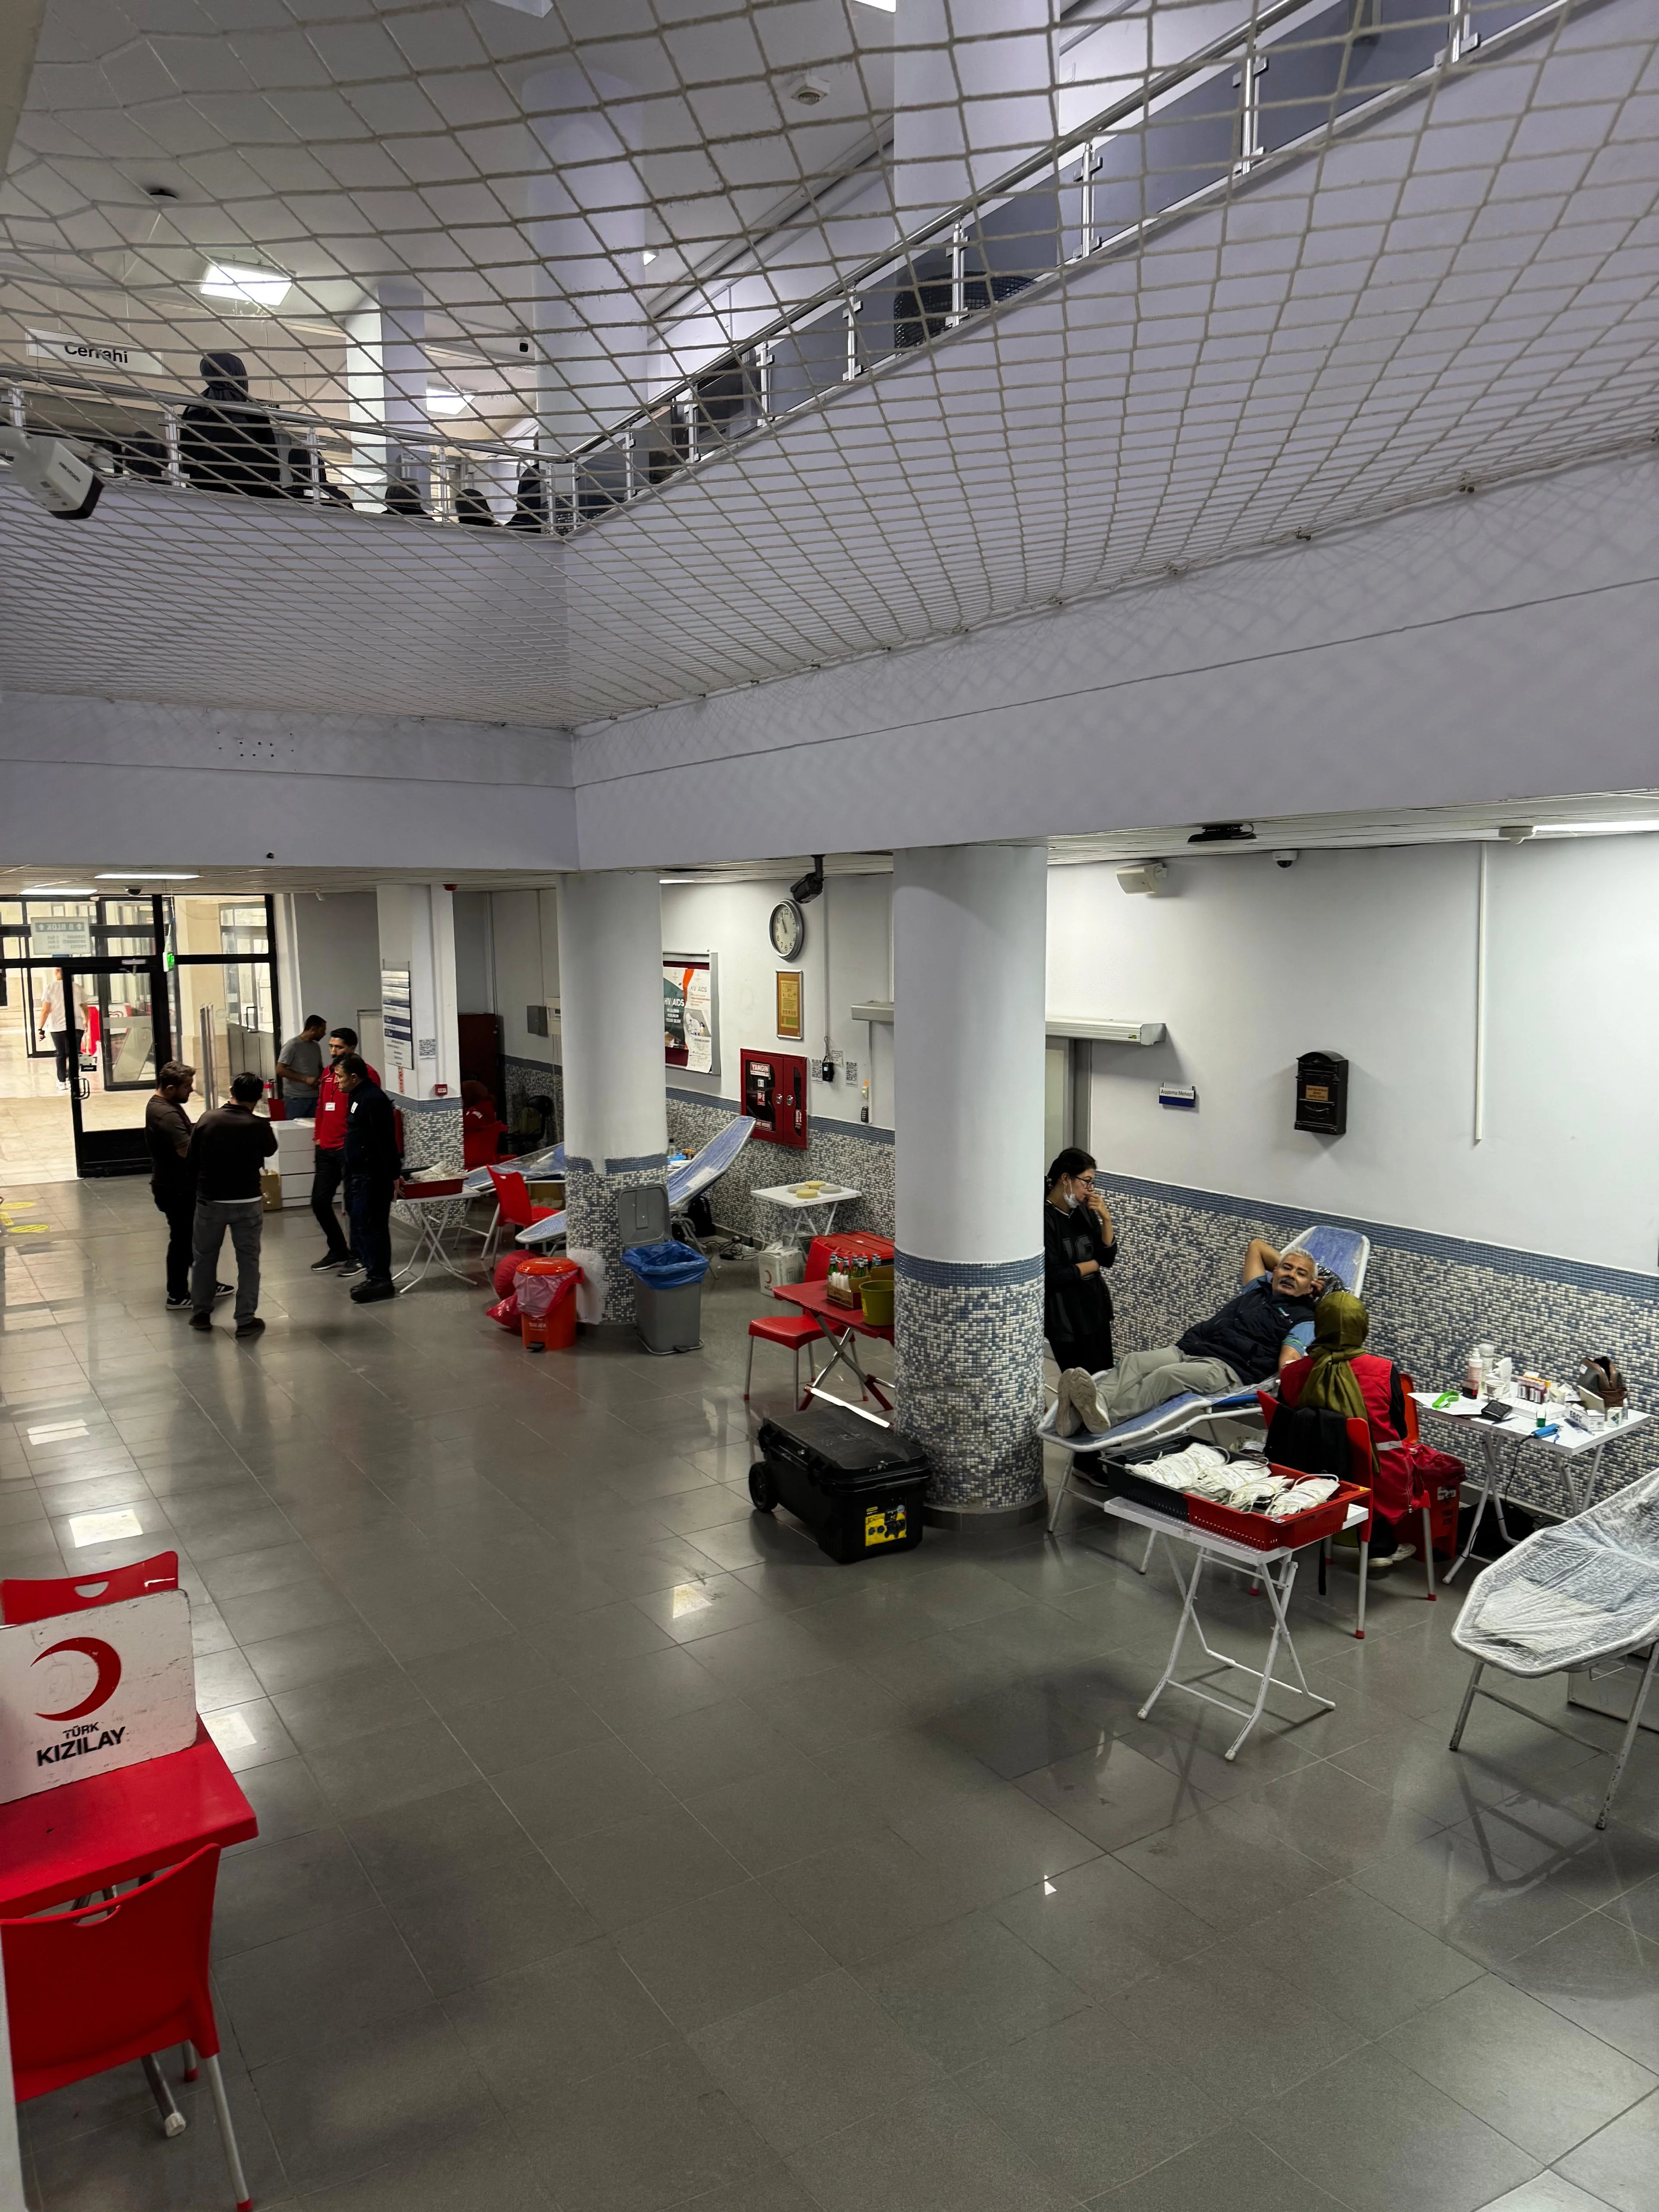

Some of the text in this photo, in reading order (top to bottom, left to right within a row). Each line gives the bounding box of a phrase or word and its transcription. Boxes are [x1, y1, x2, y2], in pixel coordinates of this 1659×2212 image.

[752, 1063, 769, 1072] YANGIN
[62, 1721, 100, 1739] TÜRK
[36, 1726, 126, 1767] KIZILAY
